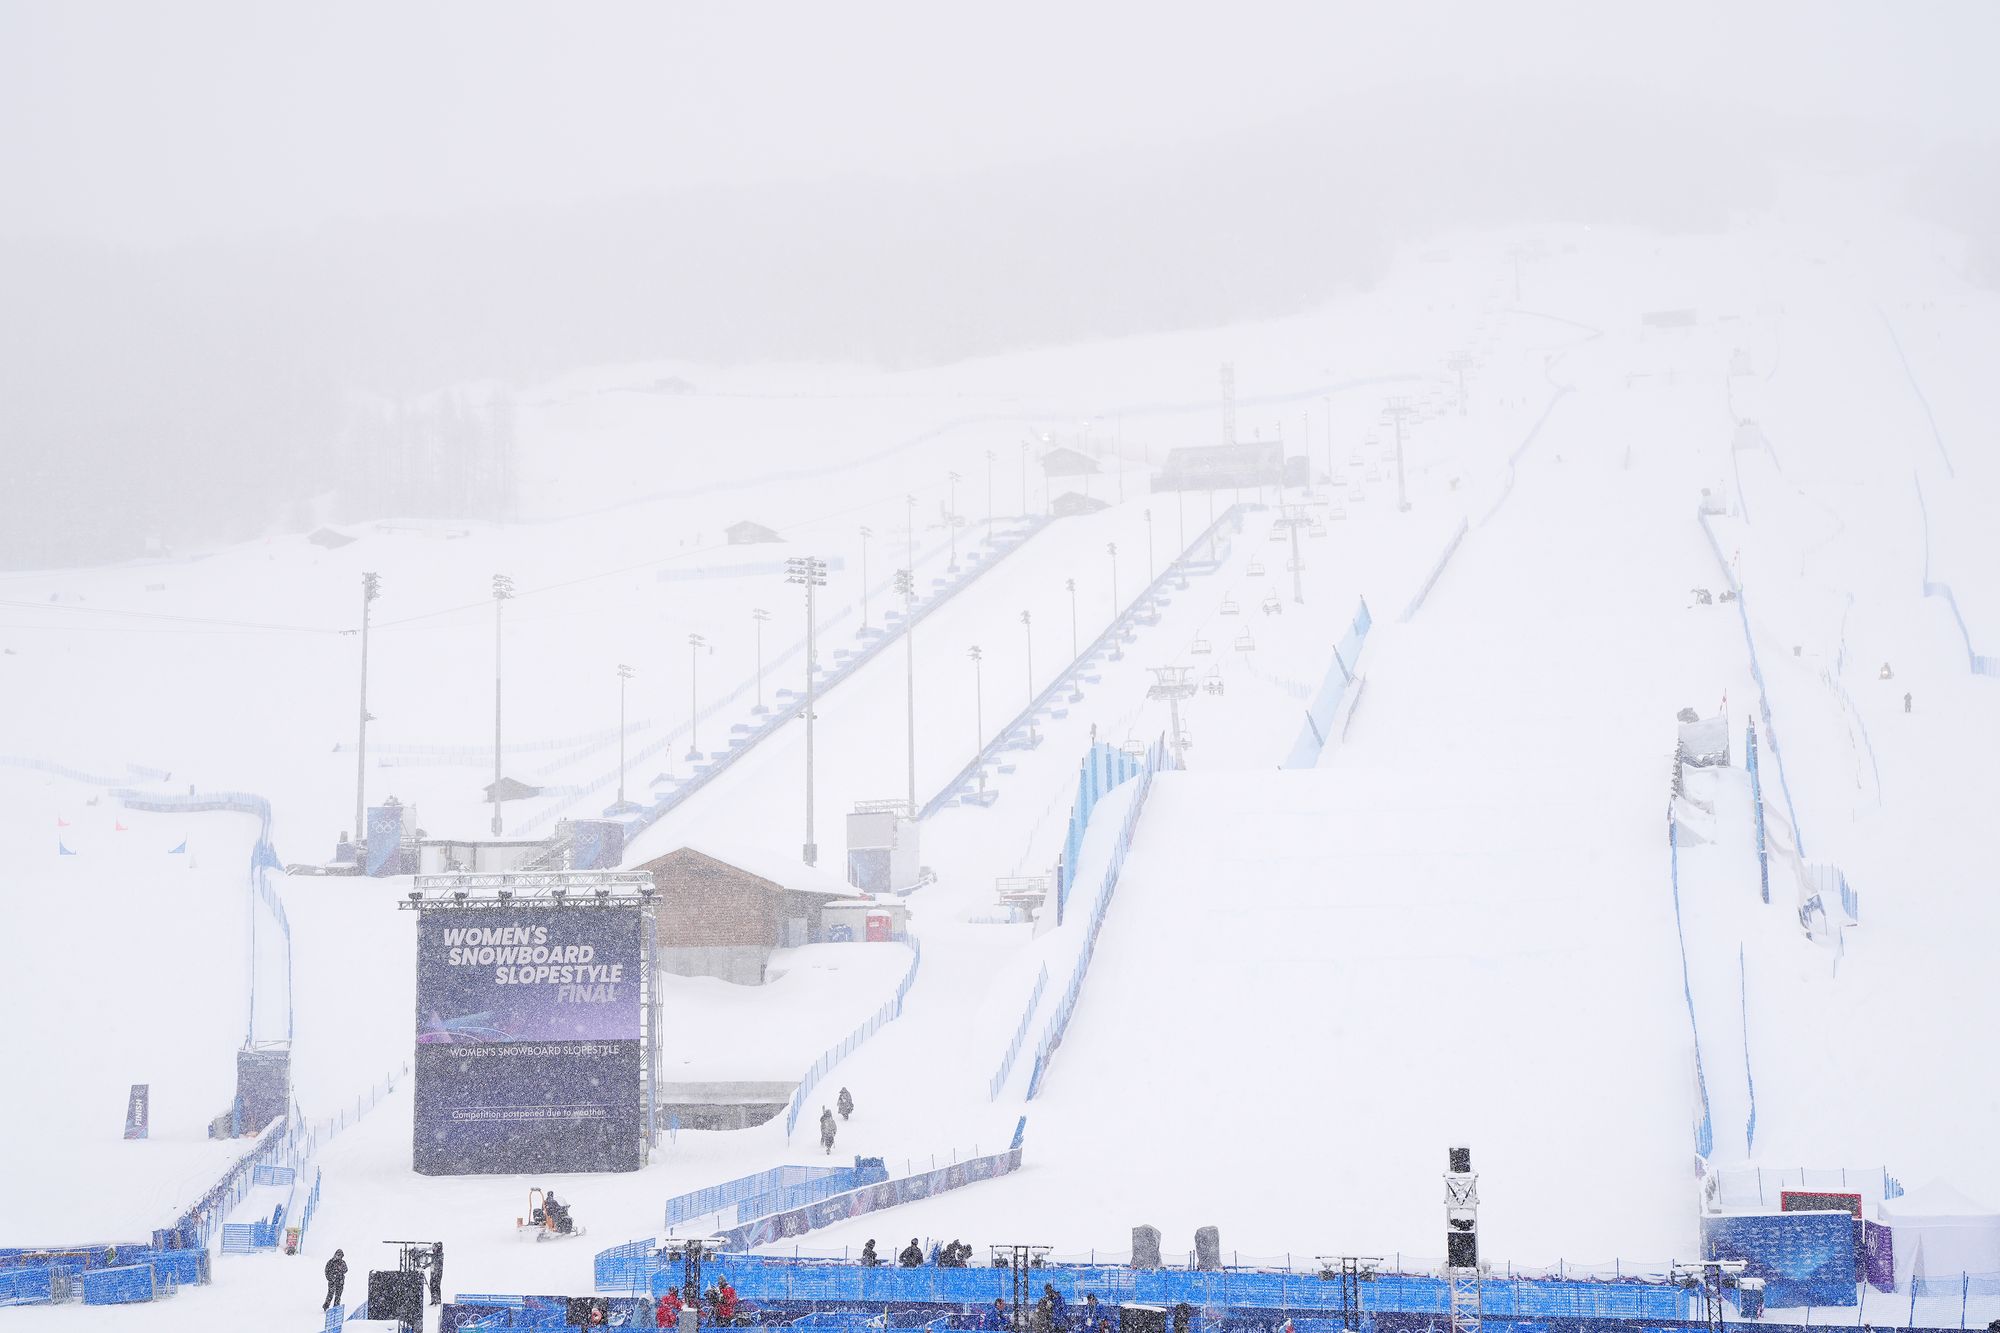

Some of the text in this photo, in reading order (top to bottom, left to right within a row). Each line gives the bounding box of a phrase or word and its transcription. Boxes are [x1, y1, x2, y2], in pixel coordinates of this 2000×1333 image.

[443, 925, 548, 946] WOMEN'S
[448, 945, 594, 966] SNOWBOARD
[495, 964, 623, 984] SLOPESTYLE
[557, 984, 617, 1004] FINAL
[450, 1044, 620, 1057] WOMEN'S SNOWBOARD SLOPESTYLE
[452, 1107, 606, 1120] Competition postponed due to weather
